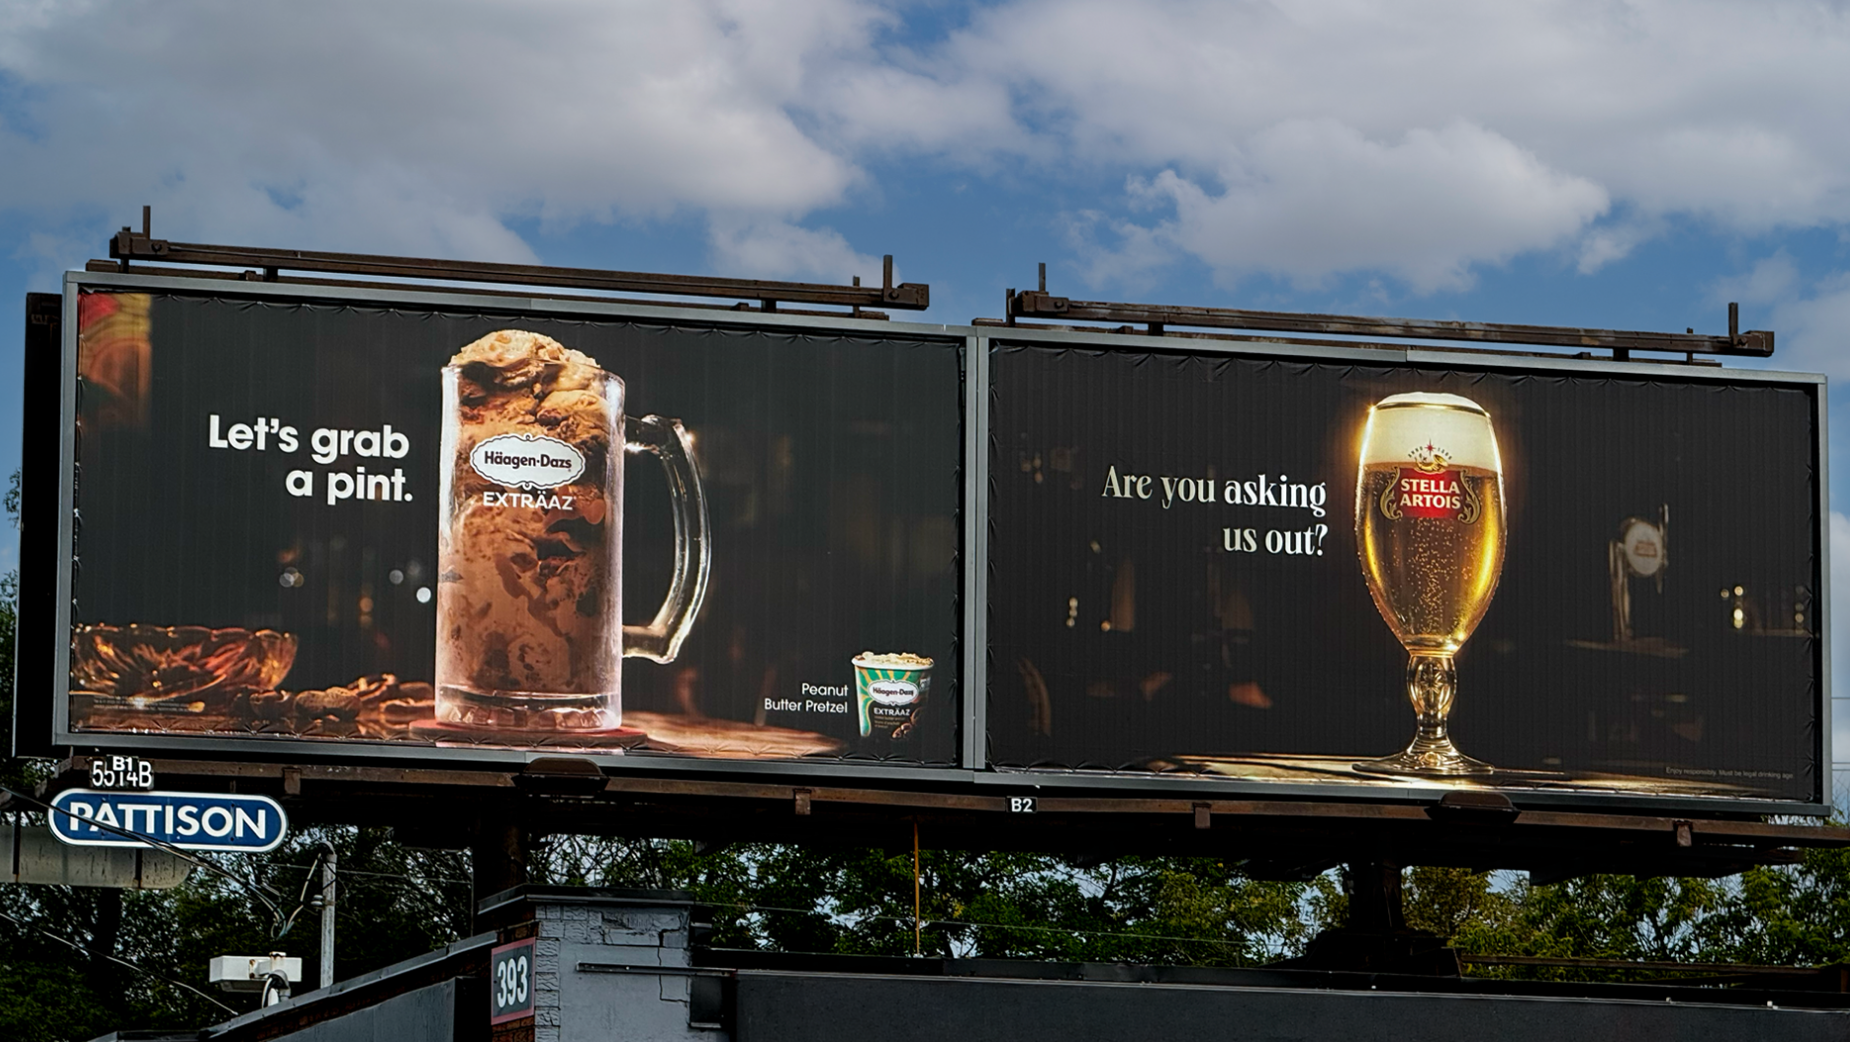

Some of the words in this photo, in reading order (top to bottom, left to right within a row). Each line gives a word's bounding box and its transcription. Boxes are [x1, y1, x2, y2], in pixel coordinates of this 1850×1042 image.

[209, 414, 299, 453] Let's
[311, 424, 410, 464] grab
[285, 469, 313, 497] a
[327, 466, 413, 506] pint.
[1101, 465, 1153, 499] Are
[1160, 476, 1216, 510] you
[1224, 474, 1327, 518] asking
[1400, 478, 1460, 494] STELLA
[483, 490, 573, 511] EXTRÄAZ
[1400, 494, 1461, 510] ARTOIS
[1223, 527, 1258, 552] us
[1265, 523, 1329, 556] out?
[801, 682, 849, 697] Peanut
[764, 697, 802, 712] Butter
[805, 699, 848, 714] Pretzel
[112, 755, 133, 772] B1
[1665, 766, 1682, 775] Enjoy
[1743, 770, 1757, 778] legal
[1757, 771, 1781, 779] drinking
[1011, 798, 1033, 813] B2
[69, 801, 267, 840] PATTISON
[497, 955, 528, 1008] 393
